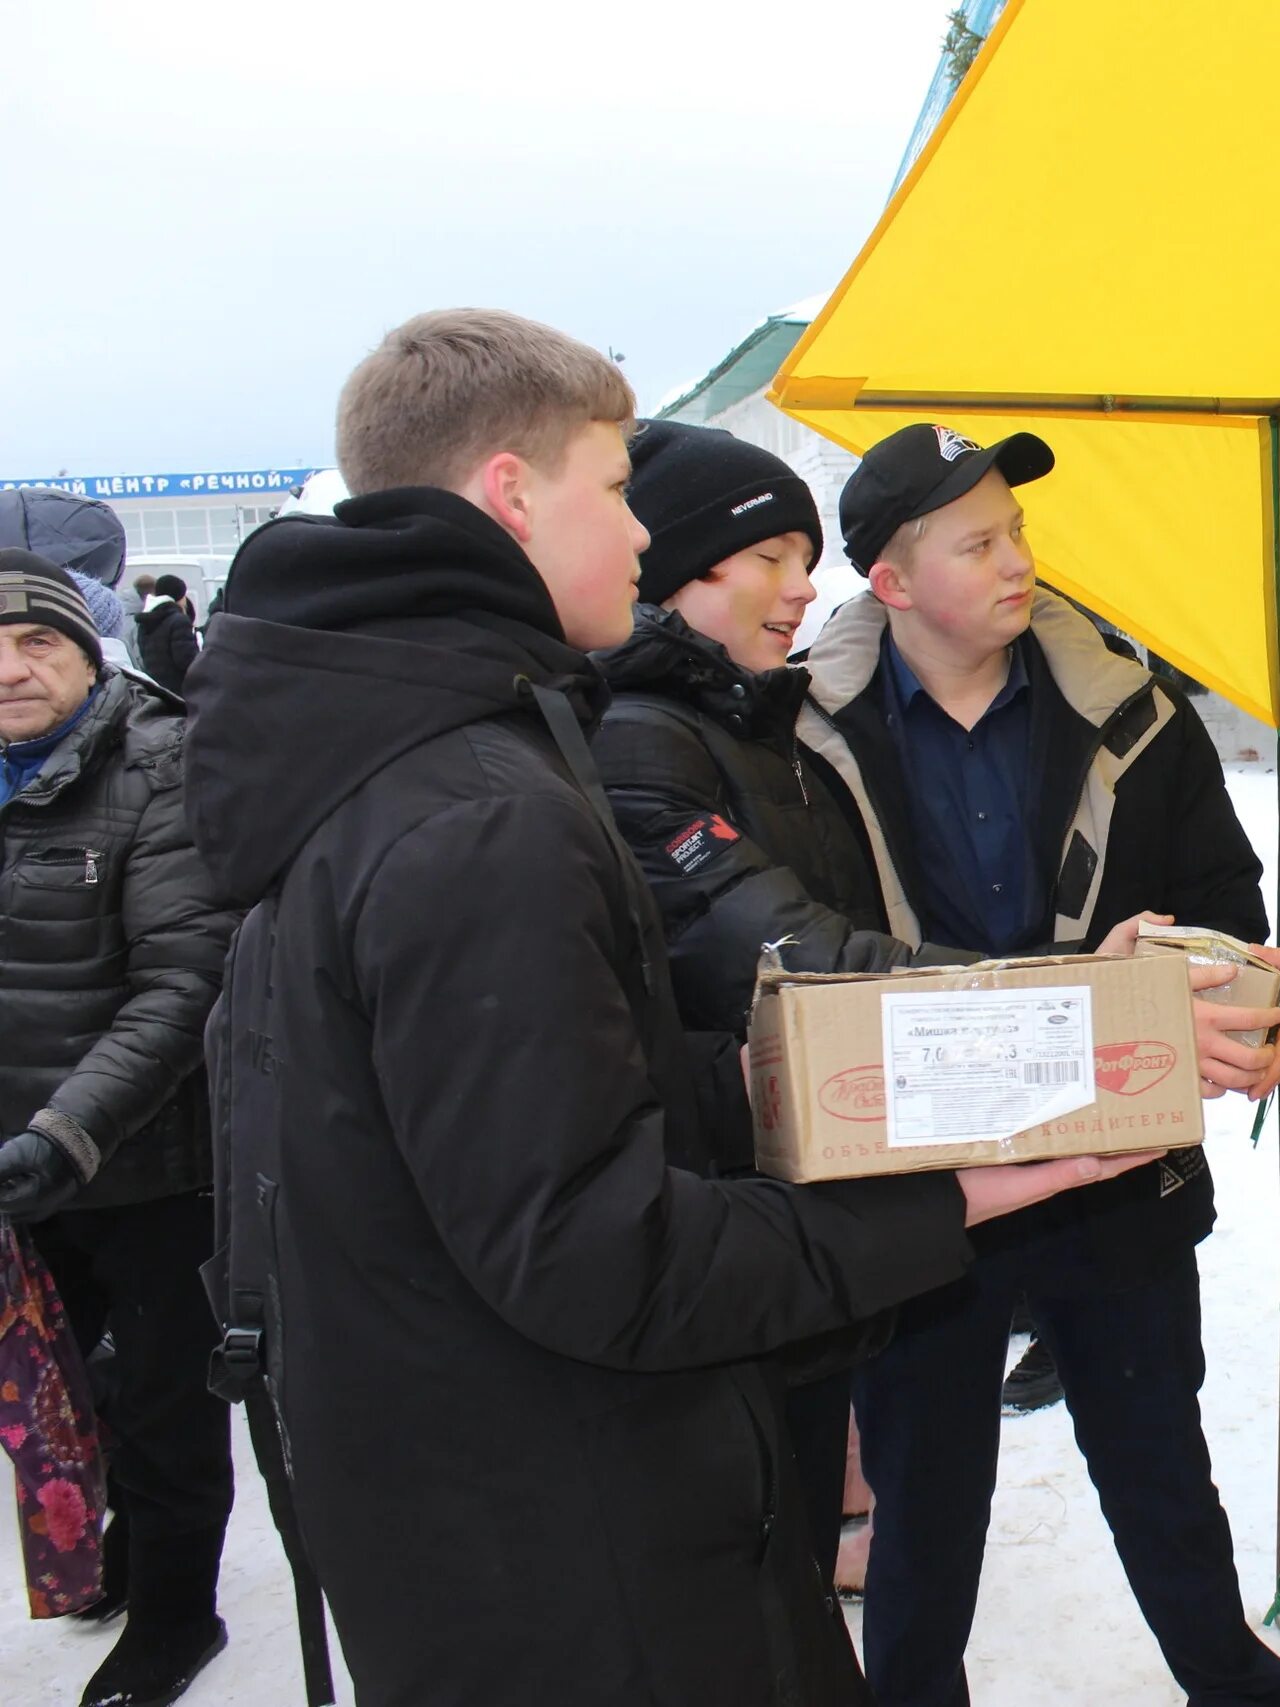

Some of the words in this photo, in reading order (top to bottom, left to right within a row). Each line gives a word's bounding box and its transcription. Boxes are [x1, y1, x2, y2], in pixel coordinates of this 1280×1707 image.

[96, 476, 169, 496] ЦЕНТР
[180, 471, 294, 490] «РЕЧНОЙ»
[731, 492, 773, 516] NEVERMIND
[1041, 1111, 1186, 1137] КОНДИТЕРЫ
